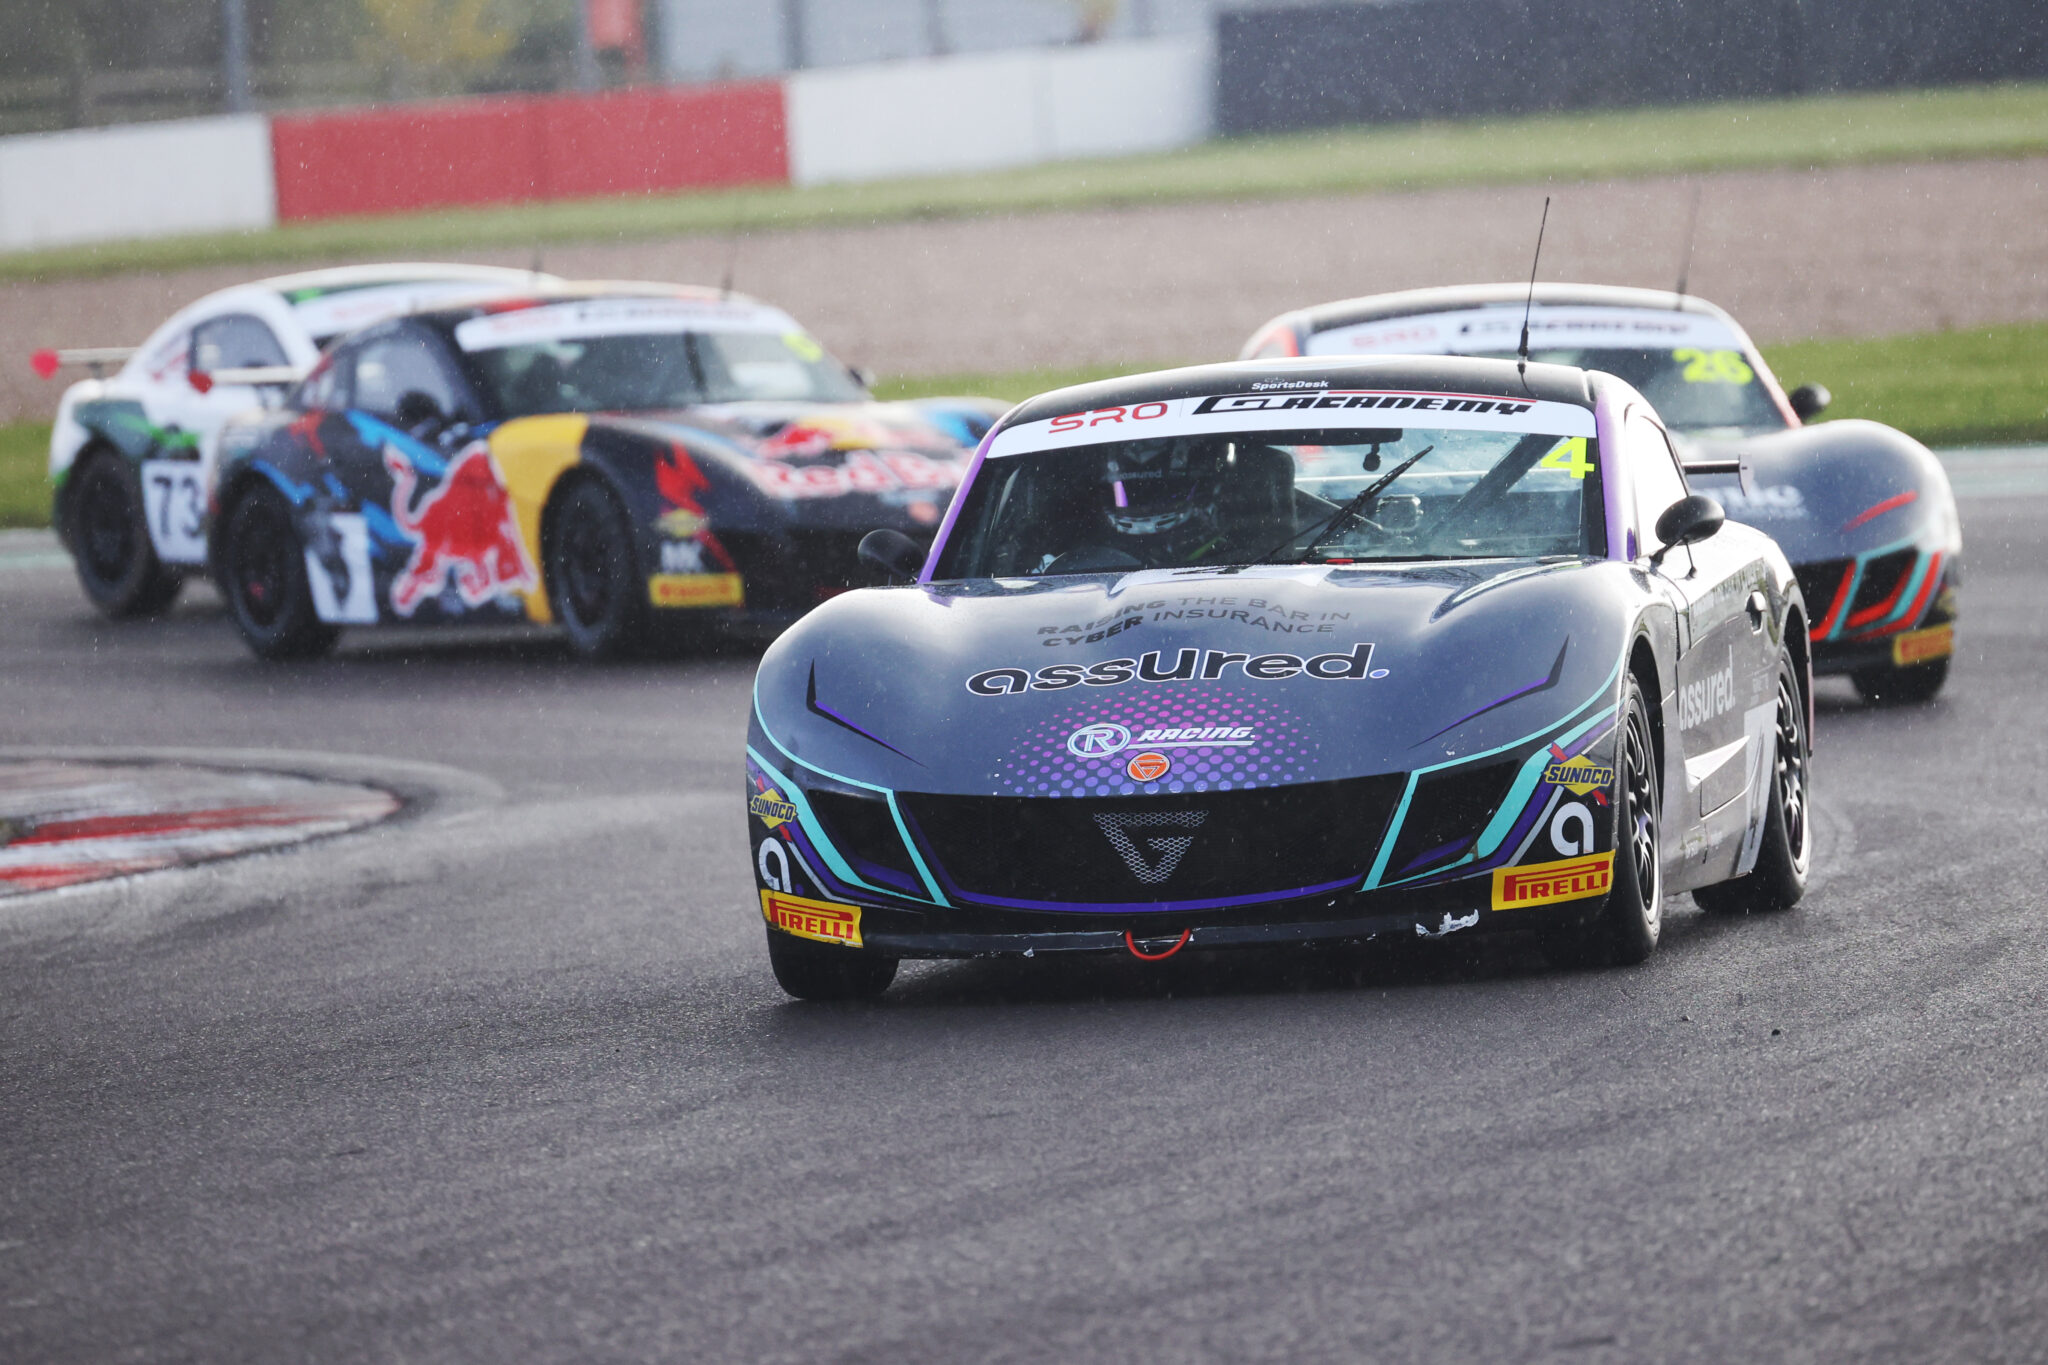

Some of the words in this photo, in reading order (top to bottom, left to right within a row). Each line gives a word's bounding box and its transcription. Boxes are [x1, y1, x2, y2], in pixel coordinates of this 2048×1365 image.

[1251, 380, 1329, 391] SportsDesk
[1672, 347, 1753, 385] 26
[1048, 402, 1168, 434] SRO
[1540, 437, 1595, 479] 4
[152, 474, 204, 539] 73
[1037, 599, 1168, 635] RAISING
[1176, 596, 1238, 607] THE
[1247, 597, 1309, 622] BAR
[1319, 610, 1351, 622] IN
[1042, 615, 1143, 648] CYBER
[1153, 608, 1336, 634] INSURANCE
[1547, 766, 1612, 785] SUNOCO
[751, 796, 795, 821] SUNOCO
[1503, 860, 1610, 902] PIRELLI
[767, 897, 854, 940] PIRELLI
